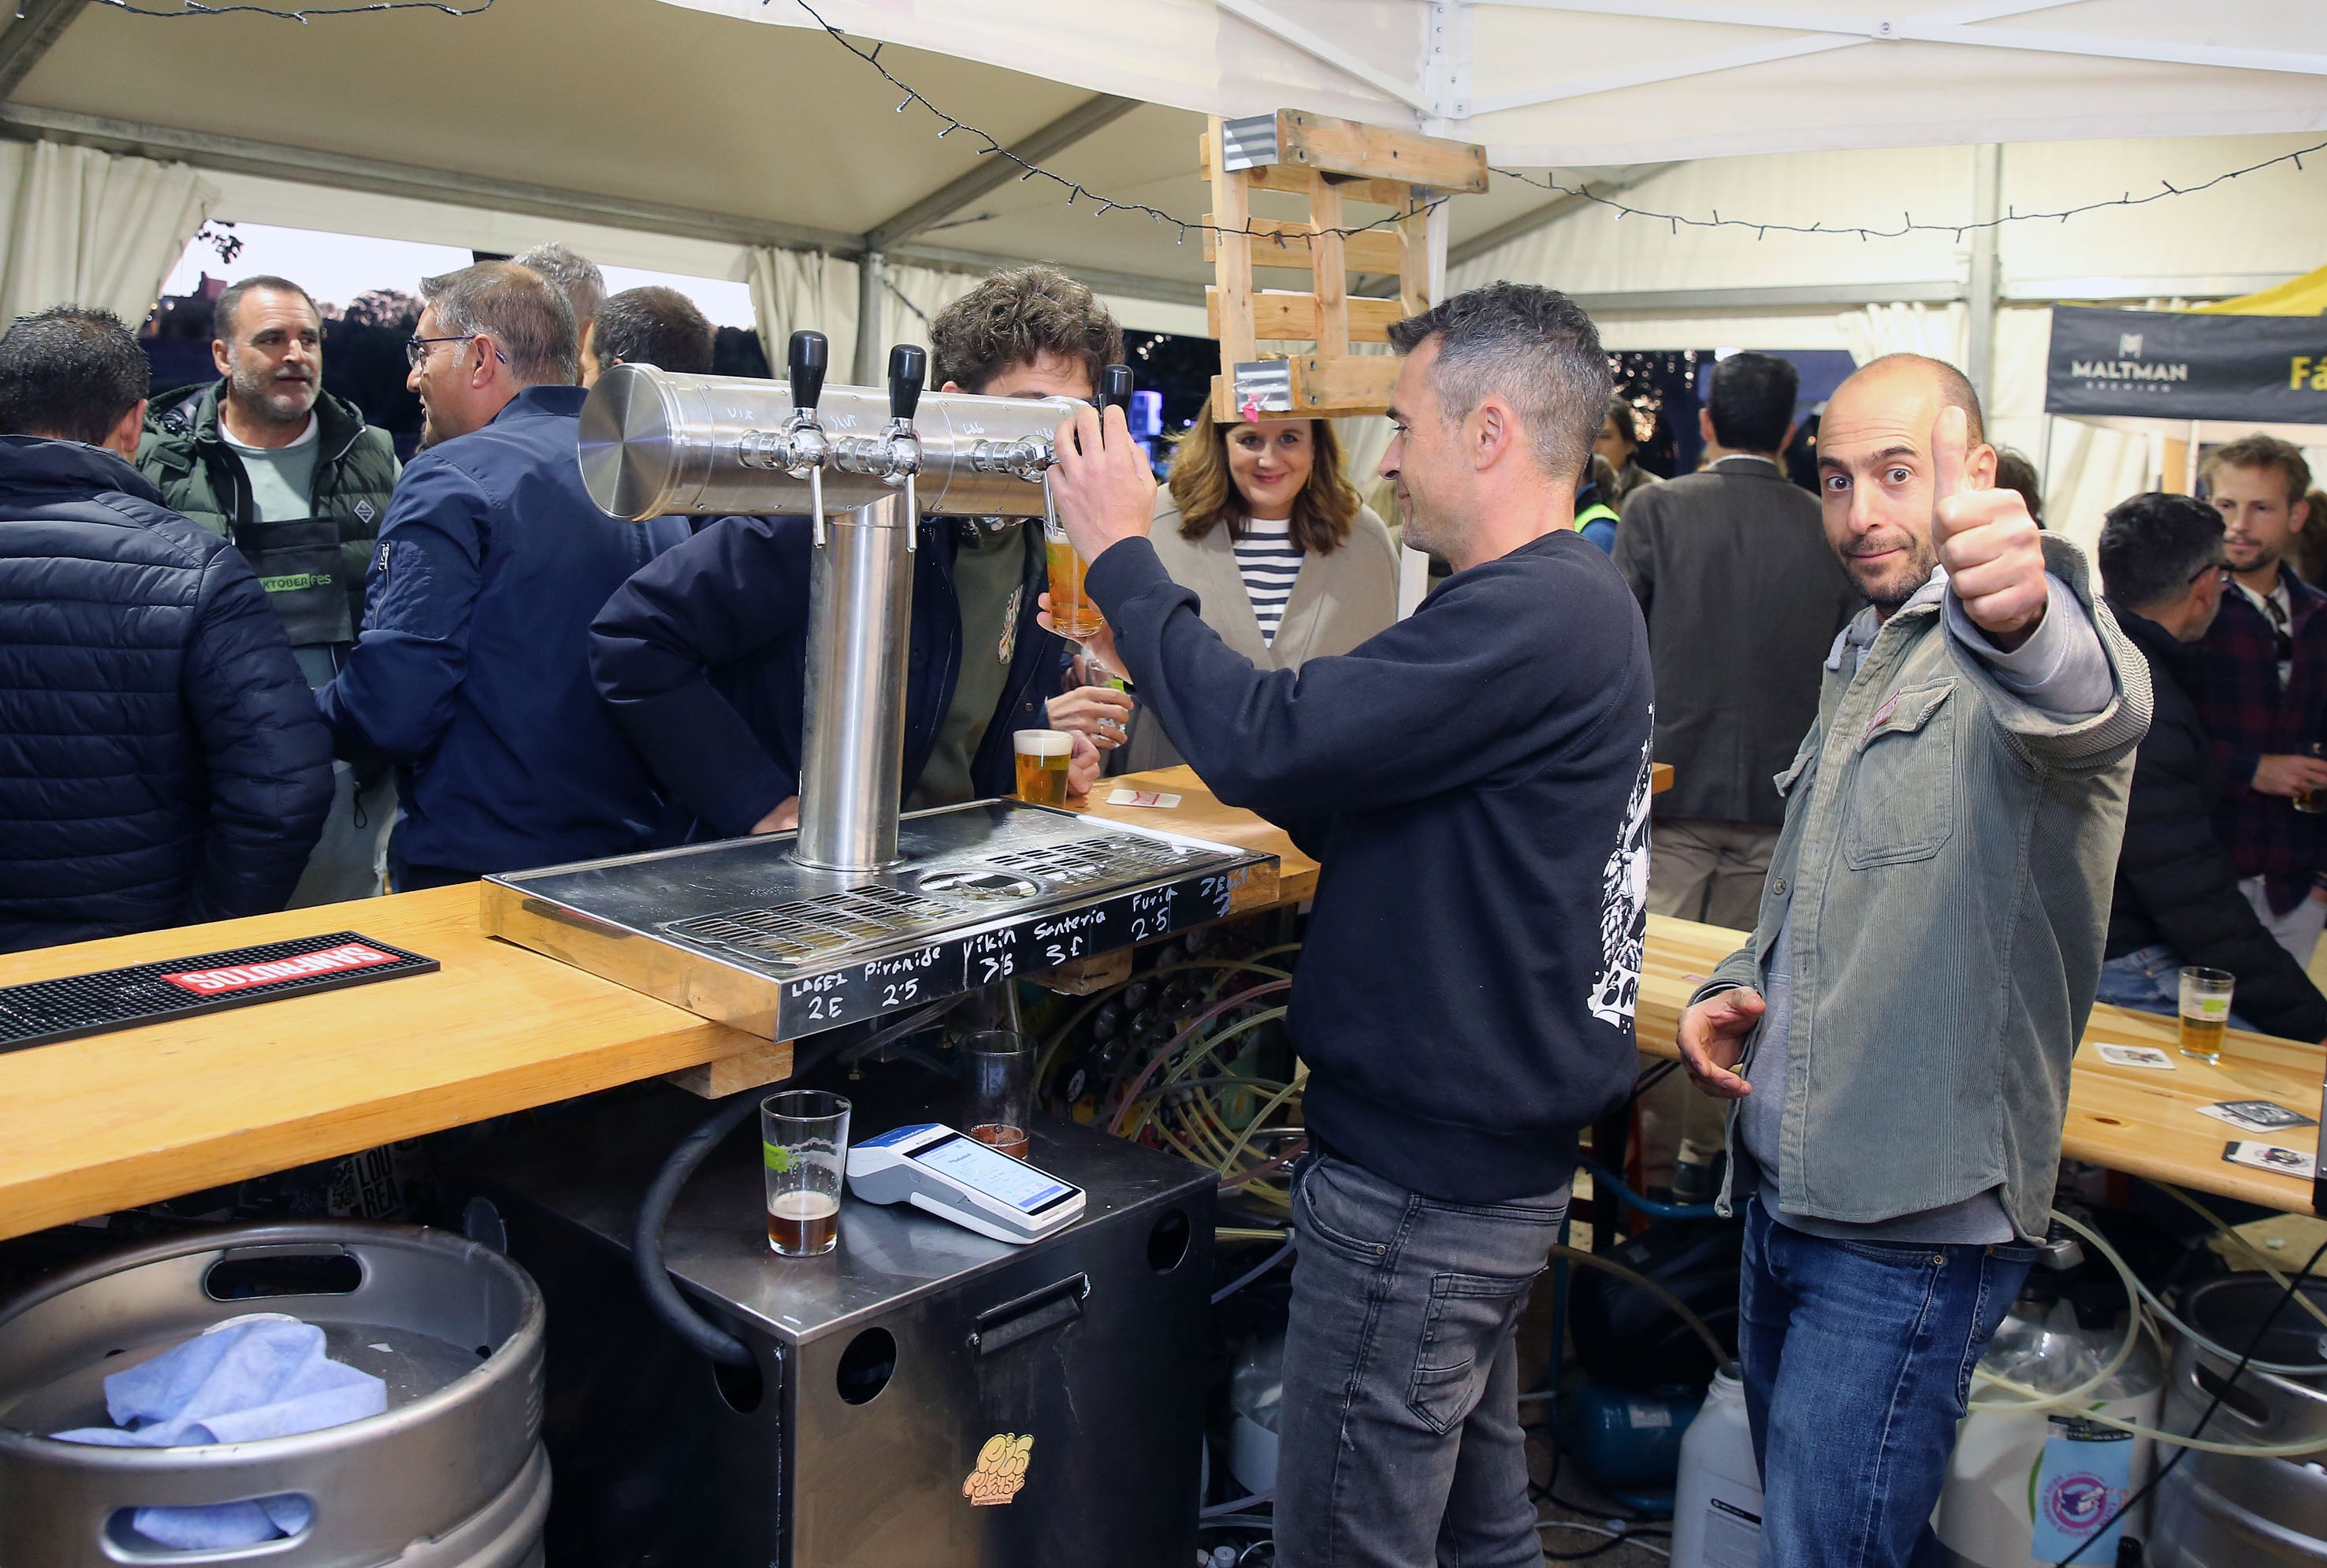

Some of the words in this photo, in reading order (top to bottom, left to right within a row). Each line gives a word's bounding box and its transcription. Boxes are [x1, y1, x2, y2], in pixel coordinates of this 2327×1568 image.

[2071, 359, 2188, 381] MALTMAN
[1132, 888, 1178, 912] Furia
[1034, 910, 1106, 941] Santeria
[180, 947, 384, 989] SANFRUTOS
